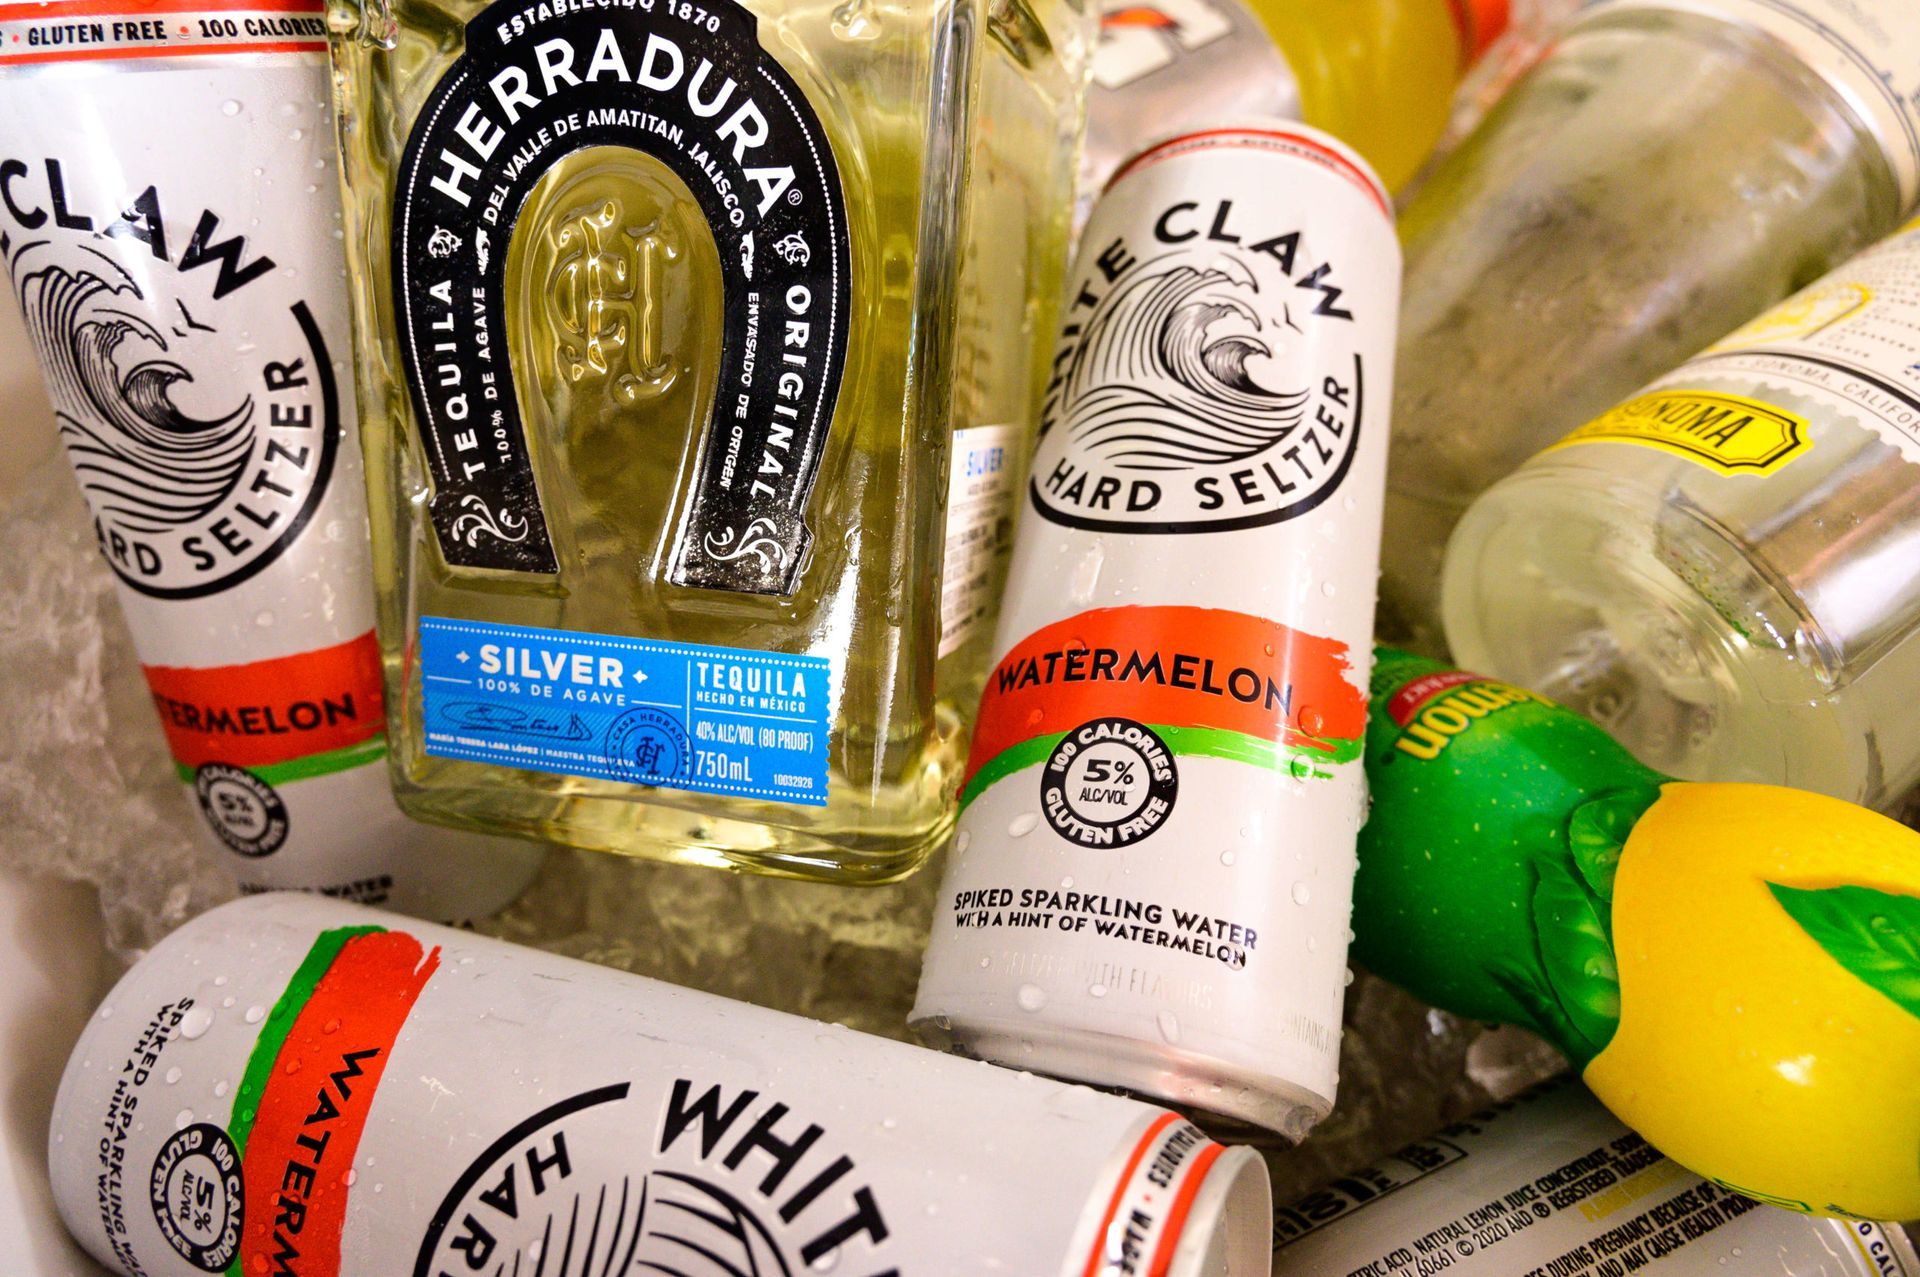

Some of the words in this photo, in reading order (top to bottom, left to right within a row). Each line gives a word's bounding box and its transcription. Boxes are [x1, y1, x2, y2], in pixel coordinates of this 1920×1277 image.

[28, 24, 105, 46] GLUTEN
[113, 20, 168, 42] FREE
[198, 18, 239, 38] 100
[245, 17, 327, 37] CALORIES
[667, 1, 721, 33] 1870
[482, 184, 511, 227] DEL
[502, 130, 553, 182] VALLE
[556, 114, 582, 138] DE
[587, 108, 685, 150] AMATITAN,
[687, 140, 746, 230] JALISCO
[0, 158, 277, 300] CLAW
[1152, 199, 1355, 322] CLAW
[473, 286, 493, 363] AGAVE
[739, 291, 761, 388] ENVASADO
[429, 279, 487, 482] TEQUILA
[749, 284, 813, 500] ORIGINAL
[482, 371, 499, 401] DE
[734, 392, 750, 420] DE
[182, 357, 313, 572] SELTZER
[491, 408, 514, 464] 100%
[1045, 456, 1163, 513] HARD
[1194, 374, 1350, 511] SELTZER
[477, 677, 521, 695] 100%
[530, 683, 553, 699] DE
[563, 686, 627, 707] AGAVE
[479, 643, 625, 689] SILVER
[696, 660, 808, 699] TEQUILA
[998, 648, 1293, 717] WATERMELON
[696, 690, 735, 705] HECHO
[739, 693, 755, 709] EN
[759, 694, 807, 714] MÉXICO
[696, 721, 715, 743] 40%
[717, 723, 756, 747] ALC/VOL
[758, 727, 778, 750] (80
[779, 728, 815, 755] PROOF)
[696, 750, 753, 783] 750mL
[1050, 742, 1077, 773] 100
[1078, 722, 1174, 787] CALORIES
[1078, 786, 1129, 807] ALC/VOL
[1082, 759, 1134, 786] 5%
[1045, 787, 1114, 845] GLUTEN
[1118, 796, 1169, 845] FREE
[954, 889, 1014, 911] SPIKED
[1019, 889, 1163, 925] SPARKLING
[1172, 909, 1258, 950] WATER
[992, 911, 1003, 927] A
[1008, 913, 1052, 930] HINT
[1058, 916, 1088, 933] OF
[1093, 919, 1248, 968] WATERMELON
[133, 1003, 176, 1055] WITH
[134, 997, 195, 1087] SPIKED
[122, 1058, 135, 1073] A
[104, 1079, 129, 1133] HINT
[98, 1137, 111, 1167] OF
[109, 1094, 139, 1235] SPARKLING
[211, 1137, 234, 1172] 100
[660, 1078, 904, 1277] WHIT
[439, 1131, 572, 1277] HAR
[1412, 1220, 1470, 1256] NATURAL
[1463, 1199, 1508, 1230] LEMON
[1503, 1183, 1541, 1211] JUICE
[1545, 1245, 1596, 1277] DURING
[1587, 1213, 1656, 1261] PREGNANCY
[1647, 1189, 1706, 1230] BECAUSE
[1696, 1181, 1720, 1207] OF
[1414, 1248, 1457, 1277] 60661
[1472, 1222, 1509, 1250] 2020
[1505, 1209, 1534, 1233] AND
[1618, 1242, 1650, 1274] MAY
[1642, 1226, 1687, 1260] CAUSE
[1676, 1202, 1727, 1242] HEALTH
